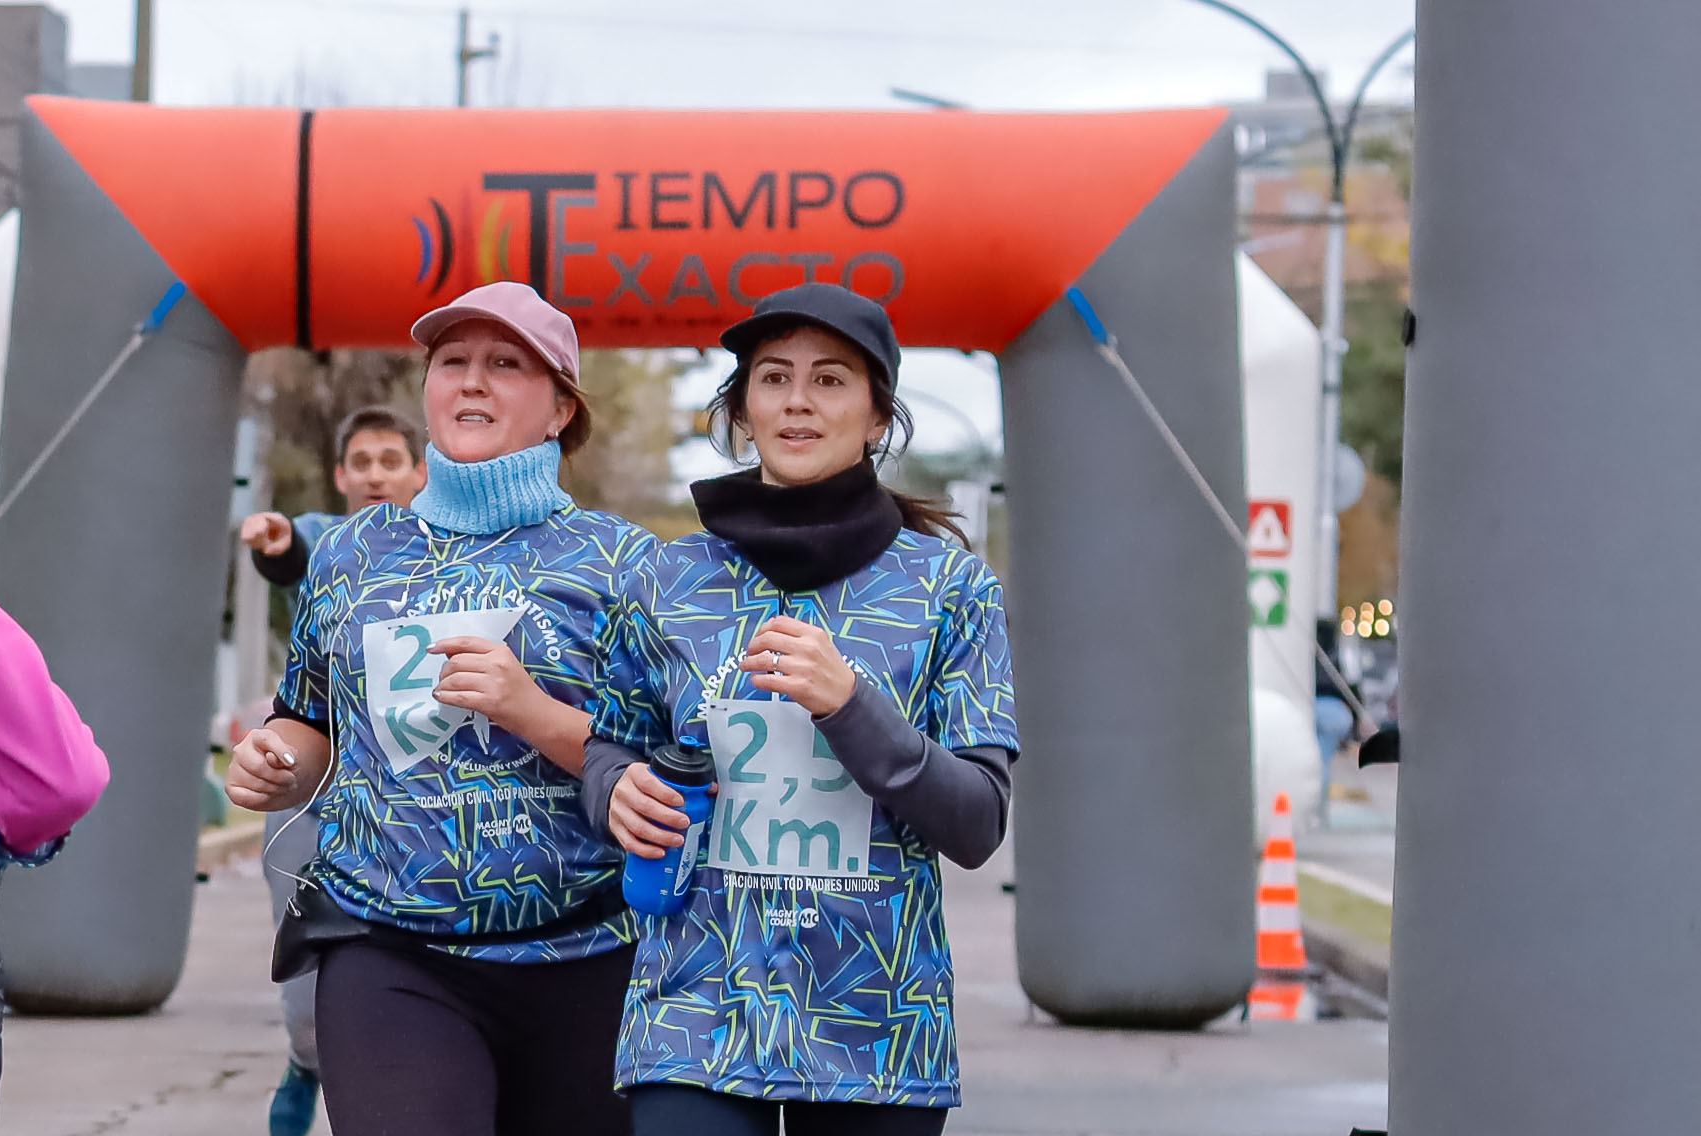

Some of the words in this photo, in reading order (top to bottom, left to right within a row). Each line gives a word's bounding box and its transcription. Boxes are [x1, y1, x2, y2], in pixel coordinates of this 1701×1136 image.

[462, 585, 476, 595] X
[481, 585, 499, 596] EL
[503, 588, 562, 661] AUTISMO
[415, 790, 465, 809] SOCIACIÓN
[466, 790, 492, 805] CIVIL
[492, 786, 511, 803] TGD
[513, 786, 545, 800] PADRES
[545, 784, 575, 798] UNIDOS
[718, 798, 859, 873] Km.
[760, 876, 783, 891] CIVIL
[784, 878, 803, 892] TGD
[805, 878, 843, 892] PADRES
[844, 878, 880, 893] UNIDOS
